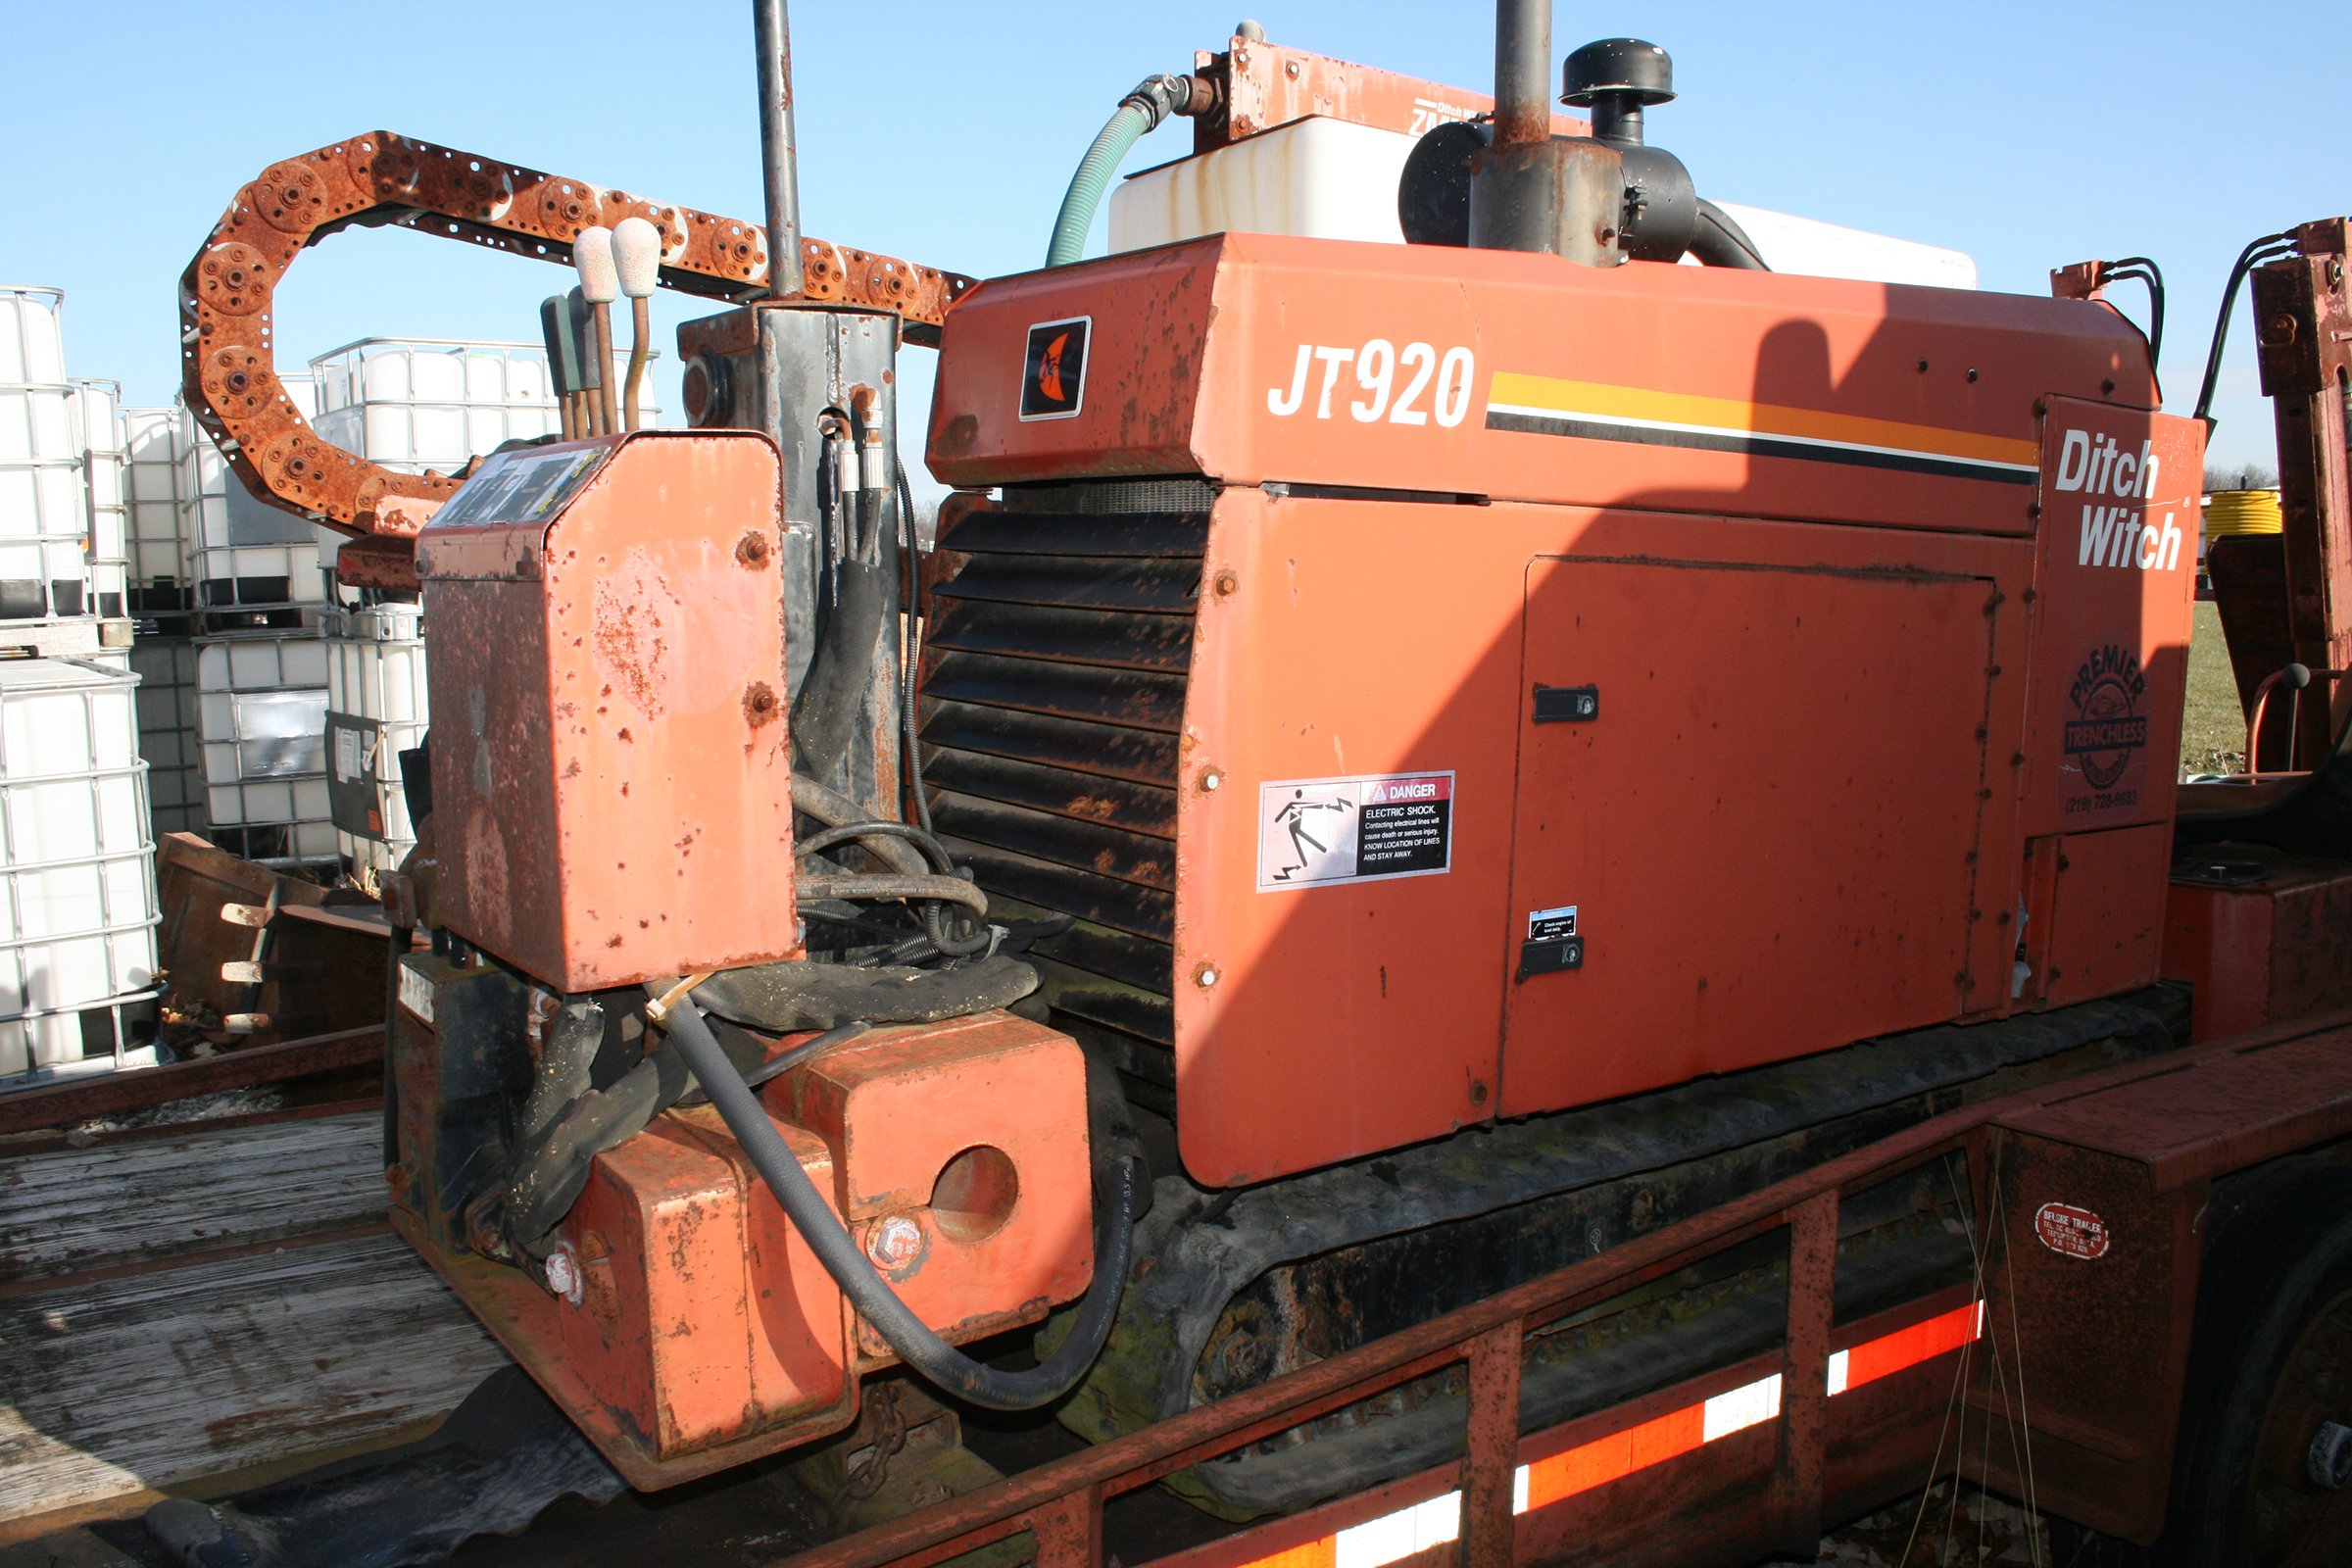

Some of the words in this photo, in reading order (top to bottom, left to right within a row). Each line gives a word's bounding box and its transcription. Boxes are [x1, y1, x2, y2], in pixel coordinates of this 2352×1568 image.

[1437, 102, 1463, 118] Ditch
[1267, 338, 1475, 428] JT920
[2055, 428, 2160, 499] Ditch
[2078, 505, 2182, 571] Witch
[2069, 644, 2145, 711] PREMIER
[2067, 720, 2147, 747] TRENCHLESS
[1390, 784, 1436, 799] DANGER
[1366, 808, 1404, 818] ELECTRIC
[1394, 818, 1417, 827] electrical
[1383, 840, 1413, 850] LOCATION
[1363, 853, 1377, 861] AND
[1377, 851, 1393, 859] STAY
